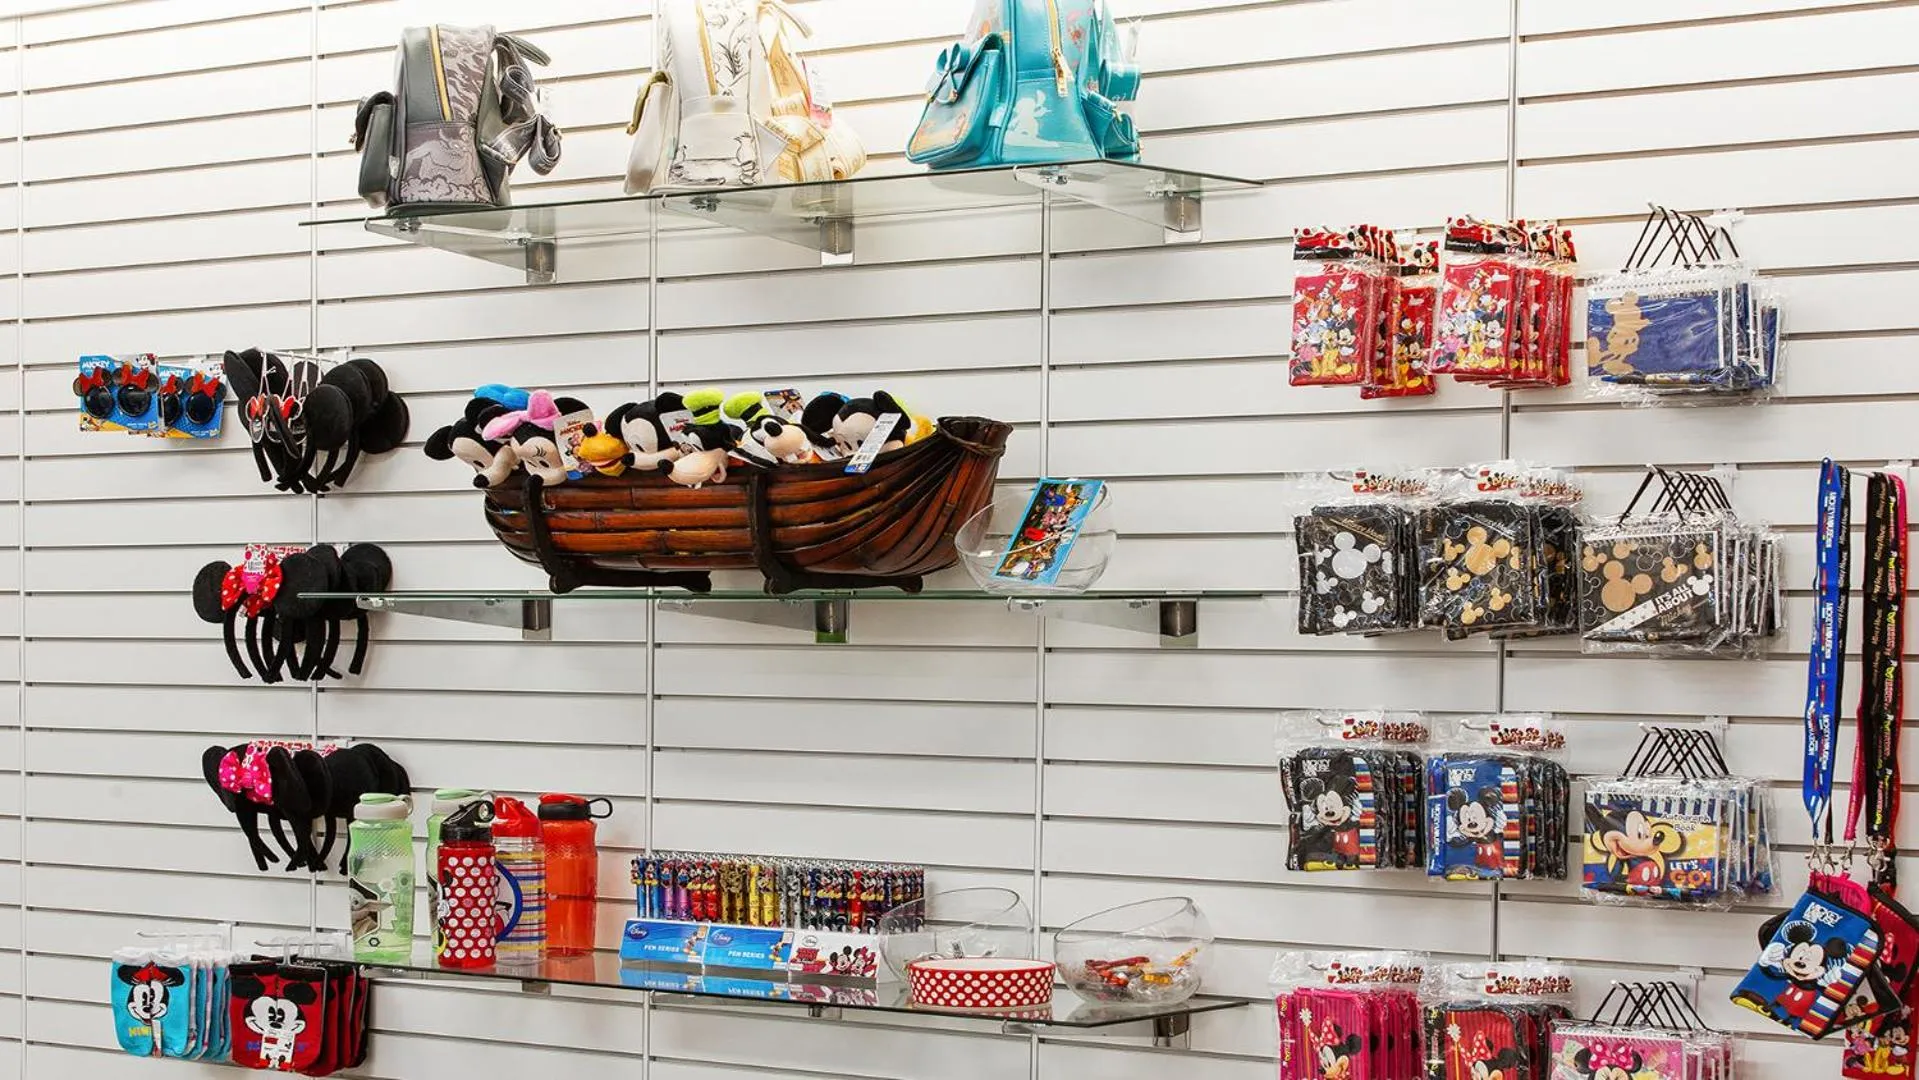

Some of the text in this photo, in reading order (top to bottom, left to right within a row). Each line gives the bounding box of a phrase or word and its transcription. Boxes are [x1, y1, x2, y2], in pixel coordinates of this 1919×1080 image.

[82, 360, 110, 369] MICKEY
[1655, 584, 1689, 605] IT'S ALL
[1658, 589, 1693, 614] ABOUT
[1661, 812, 1710, 824] Autograph
[1675, 824, 1696, 832] Book
[1670, 859, 1699, 871] LET'S
[1669, 869, 1711, 887] GO!
[658, 945, 680, 953] SERIES
[728, 950, 765, 959] PEN SERIES
